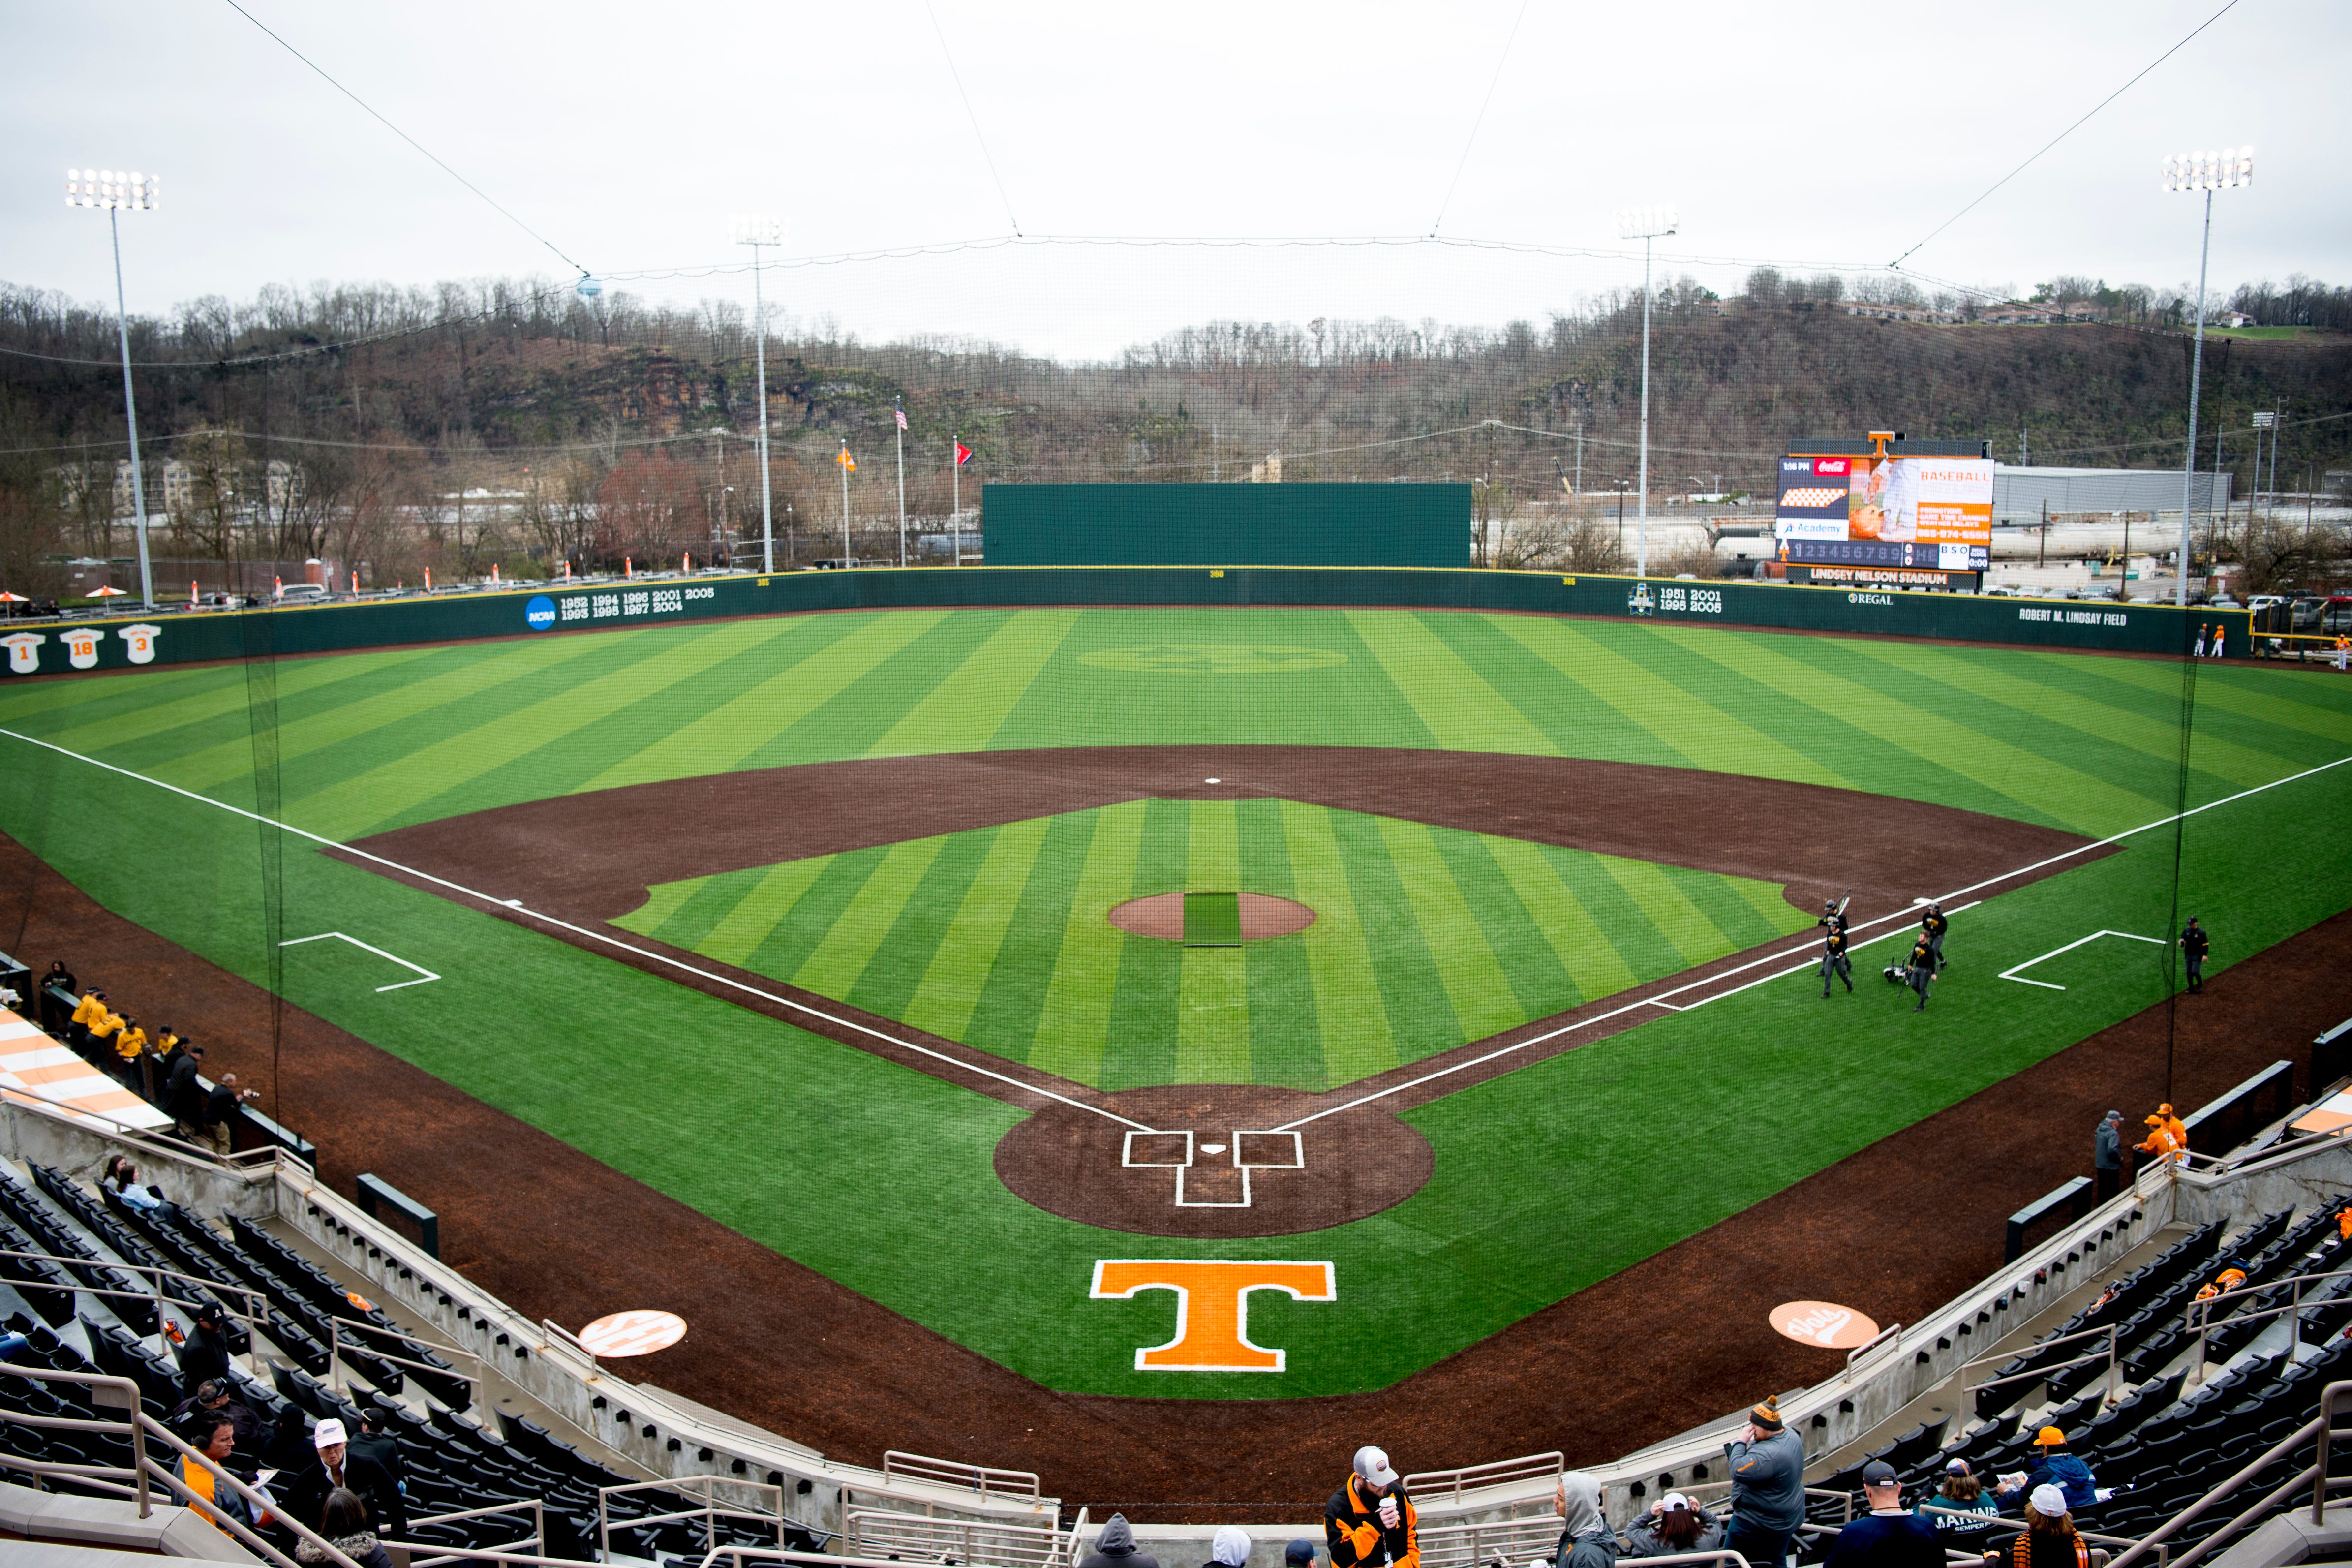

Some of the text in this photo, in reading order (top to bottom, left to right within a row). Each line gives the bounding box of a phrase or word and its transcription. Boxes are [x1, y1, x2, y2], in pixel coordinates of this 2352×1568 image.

[1868, 431, 1895, 459] T
[1921, 471, 1990, 482] BASEBALL
[1798, 524, 1841, 535] Academy
[1810, 568, 1948, 584] LINDSEY NELSON STADIUM
[560, 596, 588, 609] 1952
[592, 594, 619, 607] 1994
[652, 589, 681, 602] 2001
[685, 587, 715, 600] 2005
[1690, 589, 1721, 602] 2001
[1858, 593, 1893, 605] REGAL
[561, 600, 683, 621] 1993 1995 1997 2004
[1660, 599, 1686, 611] 1995
[1690, 600, 1722, 613] 2005
[528, 611, 556, 622] NCAA
[2019, 608, 2127, 626] ROBERT M. LINDSAY FIELD
[74, 641, 93, 656] 18
[135, 637, 147, 651] 3
[20, 646, 29, 660] 1
[1089, 1259, 1337, 1373] T
[1955, 1521, 1985, 1532] SEMPER
